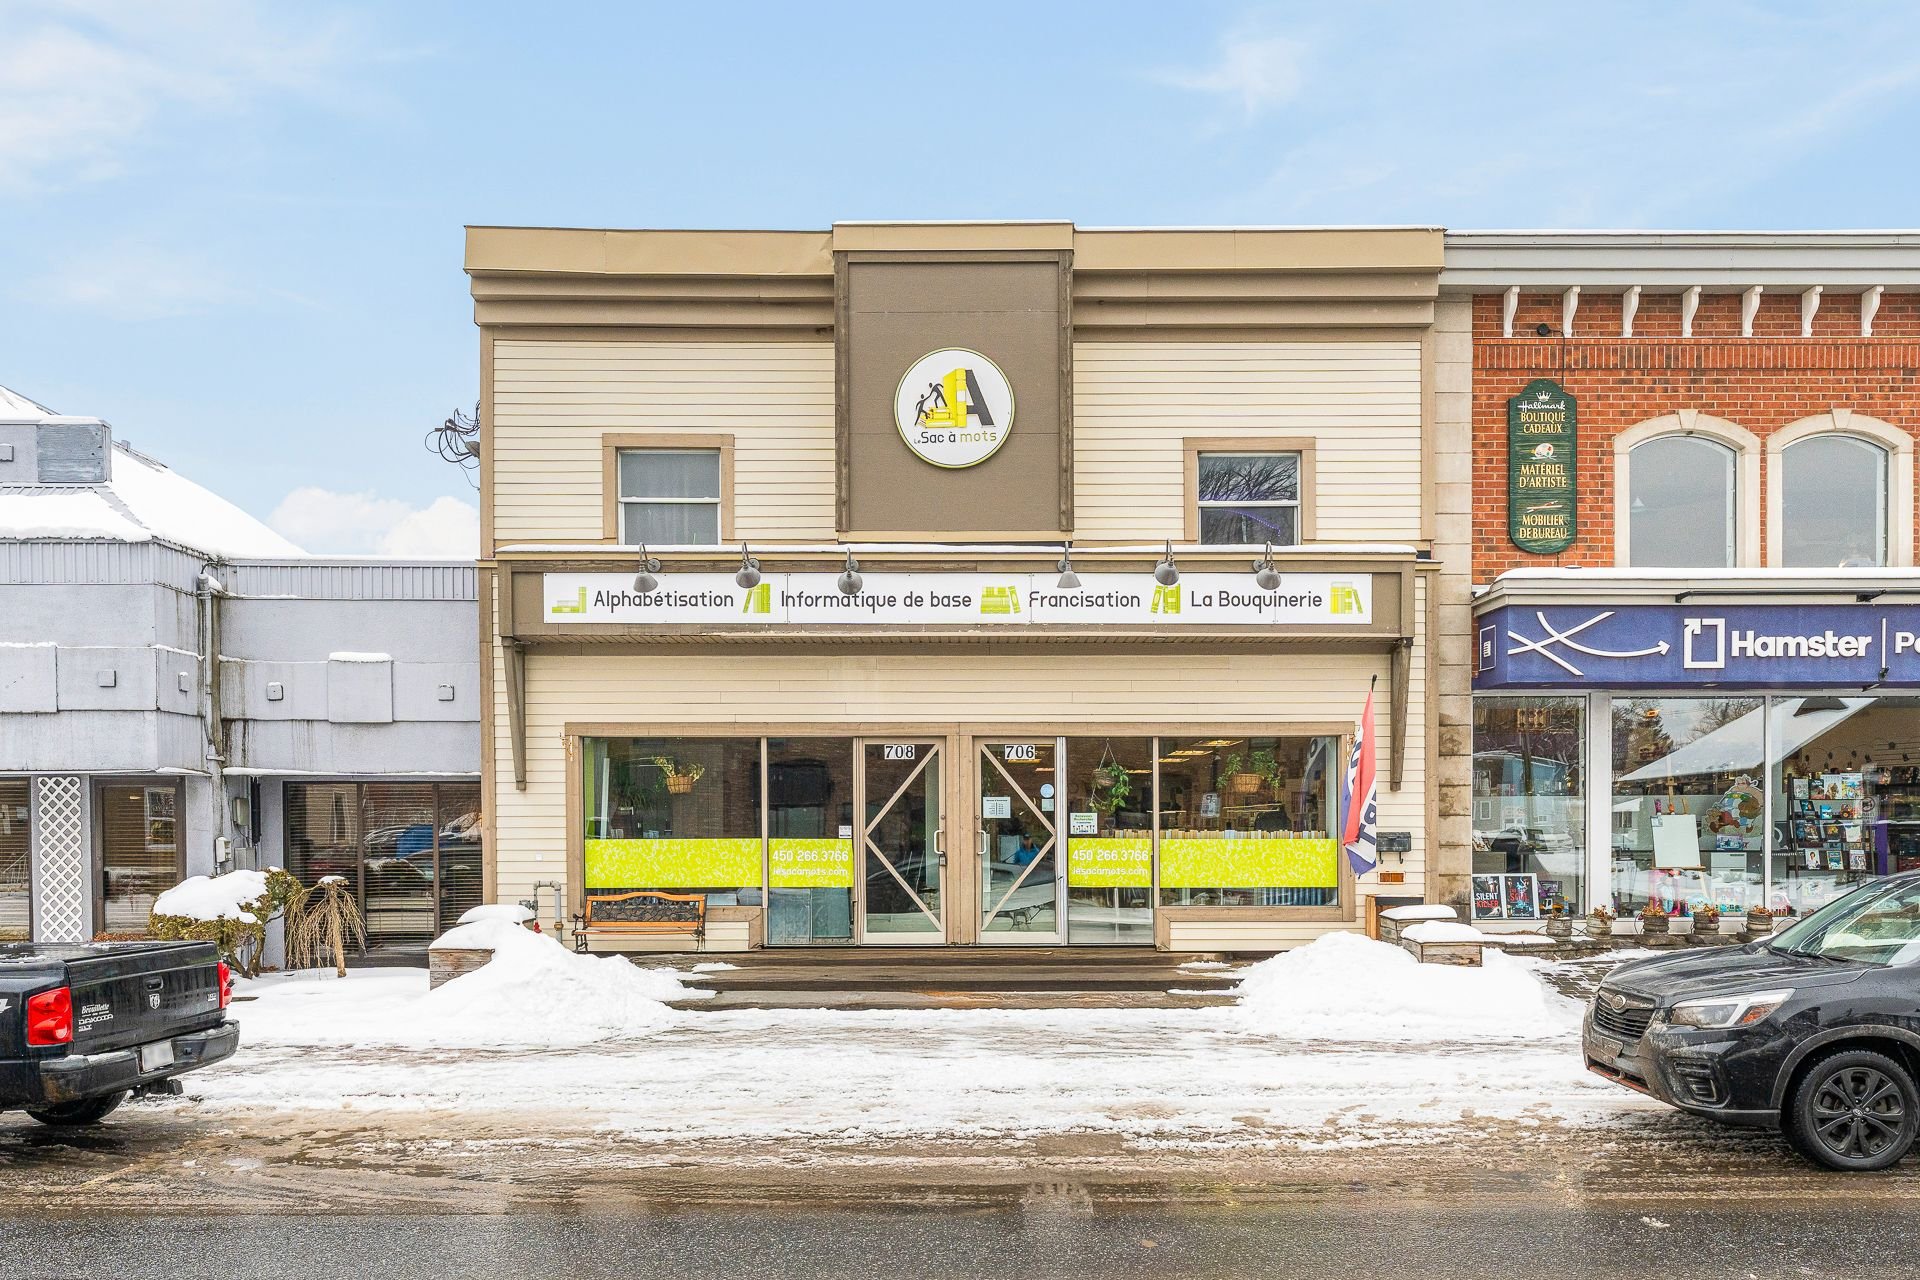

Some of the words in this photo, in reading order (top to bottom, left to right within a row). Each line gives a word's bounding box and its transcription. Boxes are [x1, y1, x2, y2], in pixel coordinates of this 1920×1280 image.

[1517, 401, 1566, 412] Hallmark
[1520, 412, 1566, 424] BOUTIQUE
[1523, 424, 1562, 434] CADEAUX
[920, 431, 945, 444] Sac
[948, 431, 956, 443] à
[960, 430, 997, 442] mots
[1520, 463, 1565, 475] MATÉRIEL
[1519, 477, 1567, 488] D'ARTISTE
[1522, 515, 1565, 526] MOBILIER
[594, 590, 734, 613] Alphabétisation
[781, 590, 897, 614] Informatique
[903, 590, 924, 607] de
[930, 590, 972, 608] base
[1029, 591, 1140, 607] Francisation
[1191, 590, 1213, 607] La
[1219, 590, 1322, 613] Bouquinerie
[1731, 630, 1871, 658] Hamster
[885, 745, 914, 759] 708
[1006, 745, 1034, 759] 706
[772, 850, 794, 862] 450
[1072, 850, 1093, 861] 450
[1476, 892, 1498, 900] SILENT
[78, 1013, 113, 1025] DAKOTA
